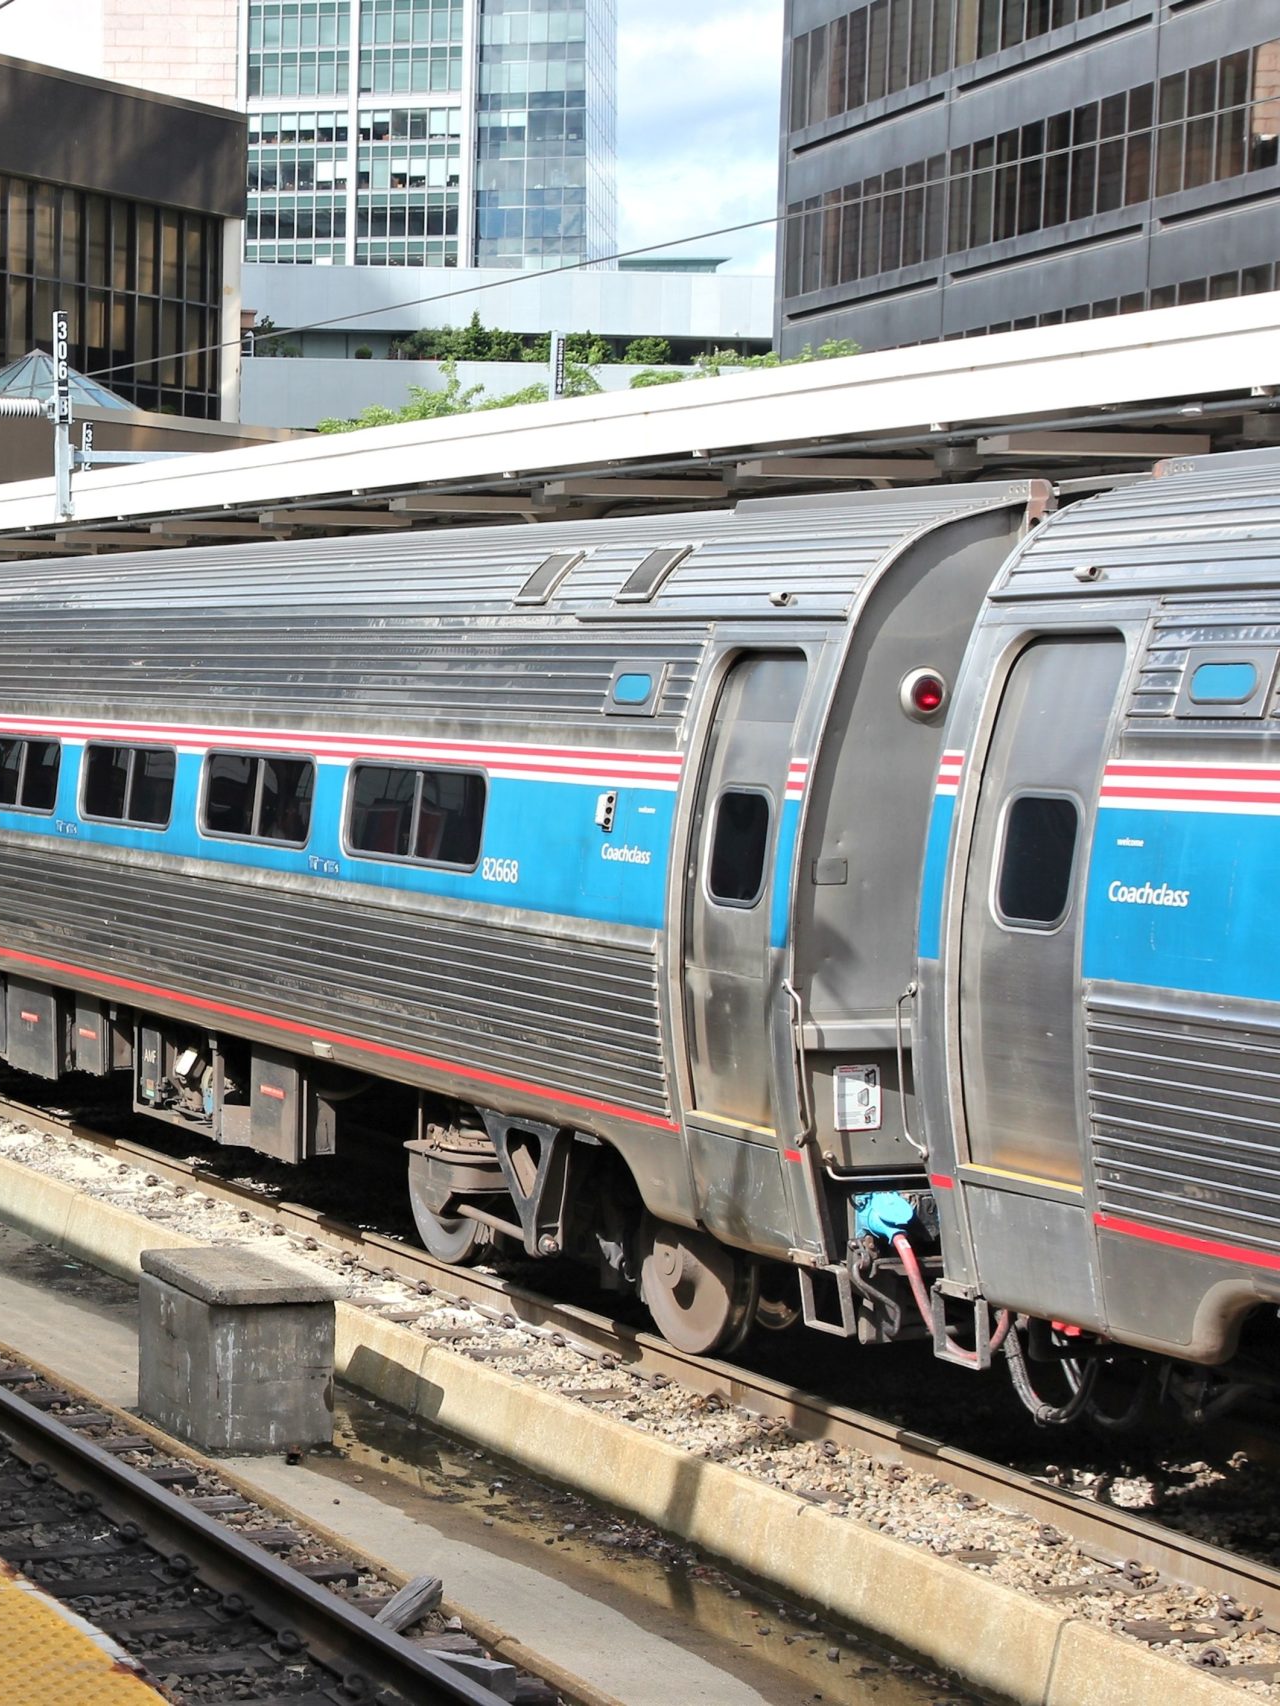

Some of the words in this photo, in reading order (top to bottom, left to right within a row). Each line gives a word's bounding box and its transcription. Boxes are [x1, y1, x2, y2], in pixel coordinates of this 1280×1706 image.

[601, 843, 652, 865] Coachclass
[1116, 837, 1145, 847] welcome
[482, 857, 519, 884] 82668
[1108, 880, 1190, 907] Coachclass
